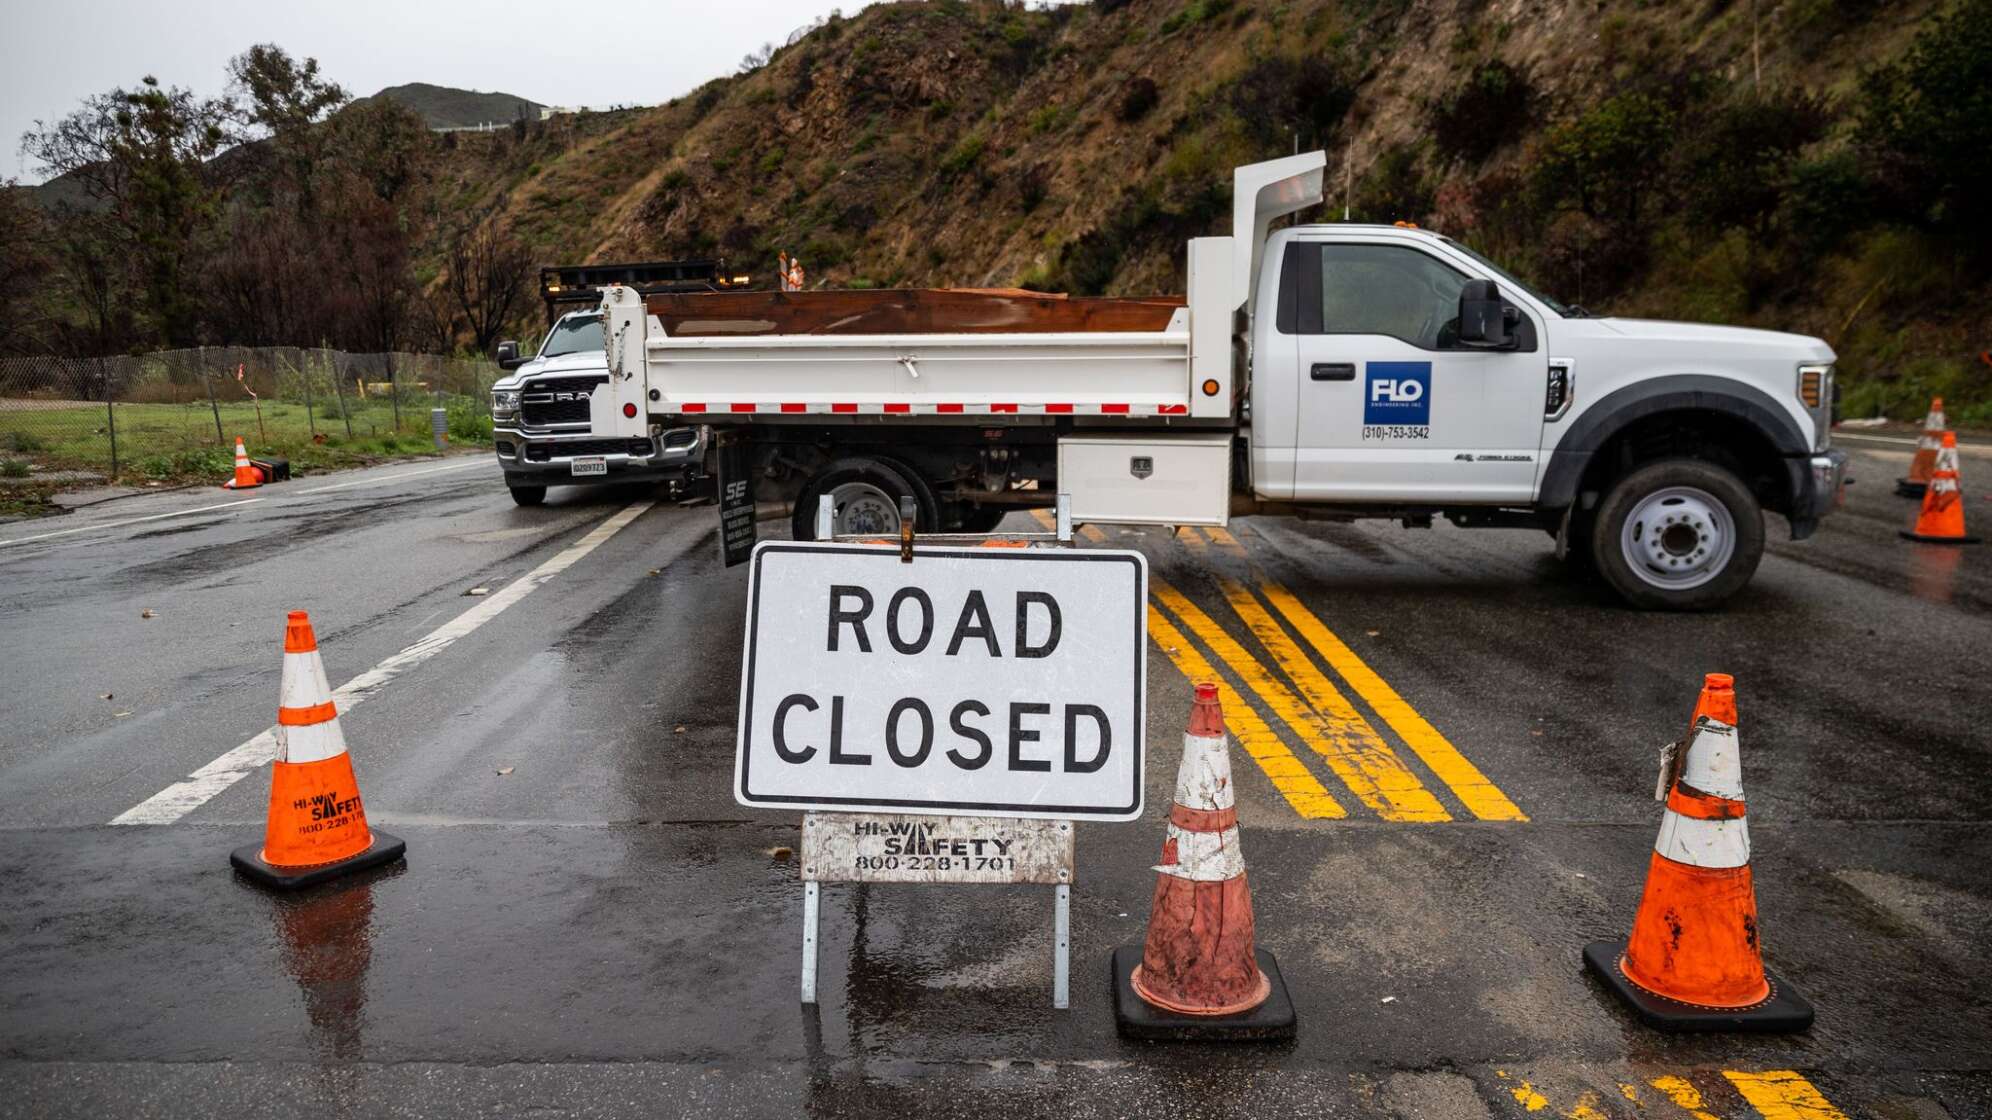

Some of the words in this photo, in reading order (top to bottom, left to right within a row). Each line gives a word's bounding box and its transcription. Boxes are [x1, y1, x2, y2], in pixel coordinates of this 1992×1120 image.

[556, 391, 591, 401] RA
[1372, 379, 1424, 401] FLO
[1362, 426, 1430, 440] (310)-753-3542
[725, 480, 748, 501] SE
[826, 584, 1063, 659] ROAD
[772, 693, 1112, 773] CLOSED
[294, 791, 337, 810] HI-WAY
[854, 822, 937, 836] HI-WAY
[884, 831, 1013, 856] SAFETY
